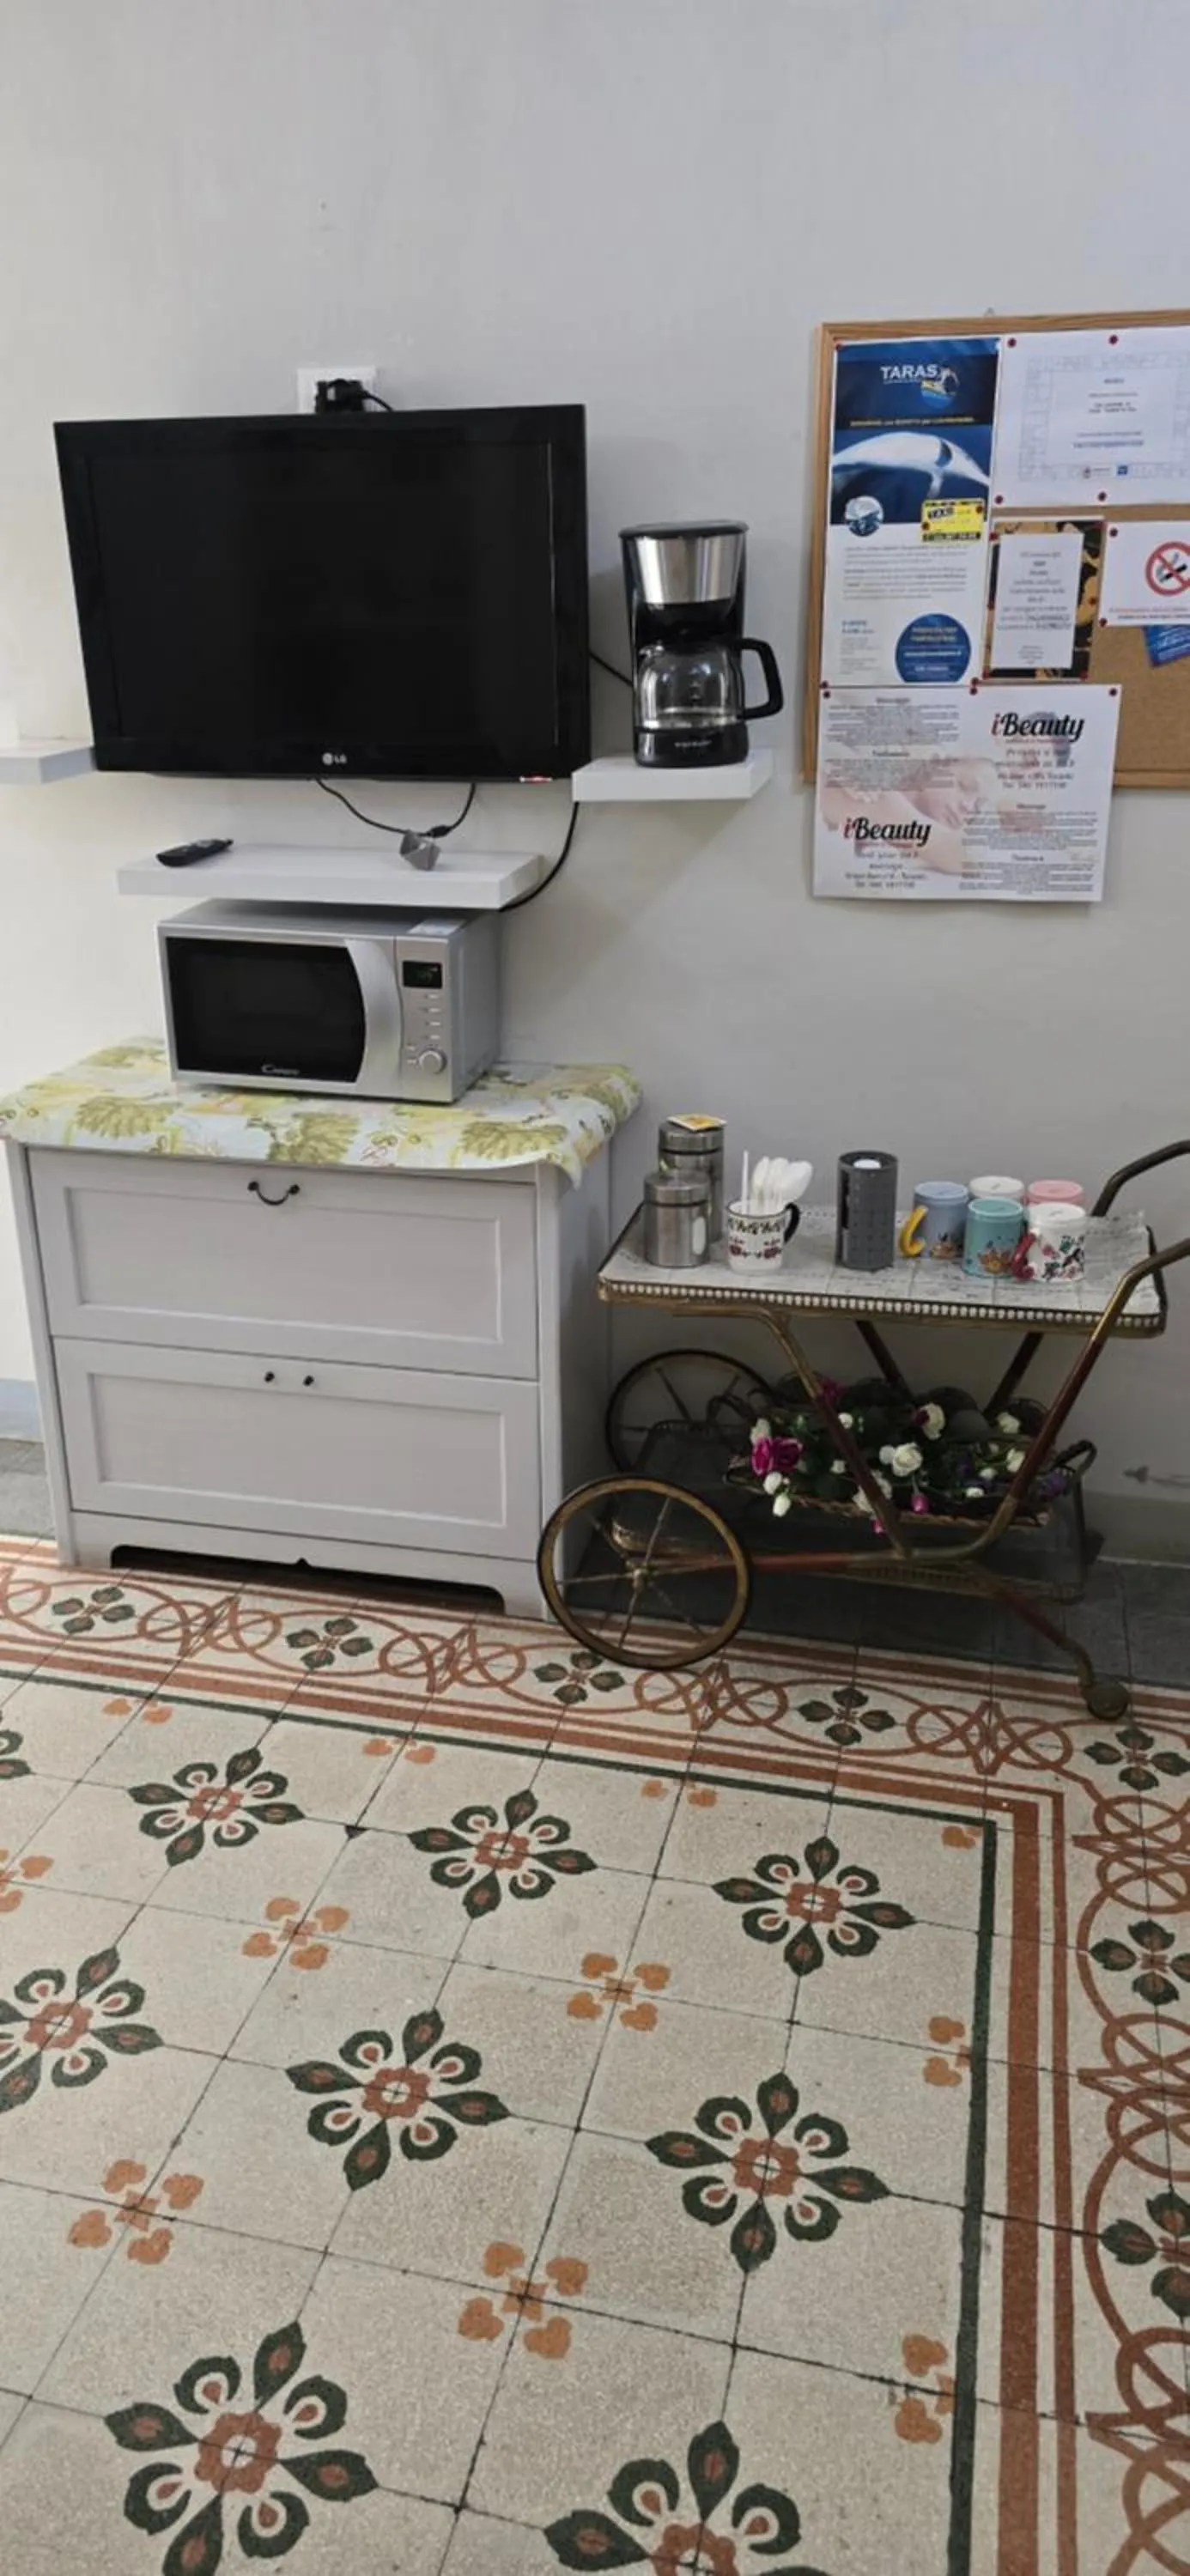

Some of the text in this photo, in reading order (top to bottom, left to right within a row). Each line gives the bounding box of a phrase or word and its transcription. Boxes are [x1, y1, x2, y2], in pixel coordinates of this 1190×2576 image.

[880, 363, 938, 380] TARAS
[991, 712, 1085, 743] iBeauty
[844, 817, 932, 848] iBeauty
